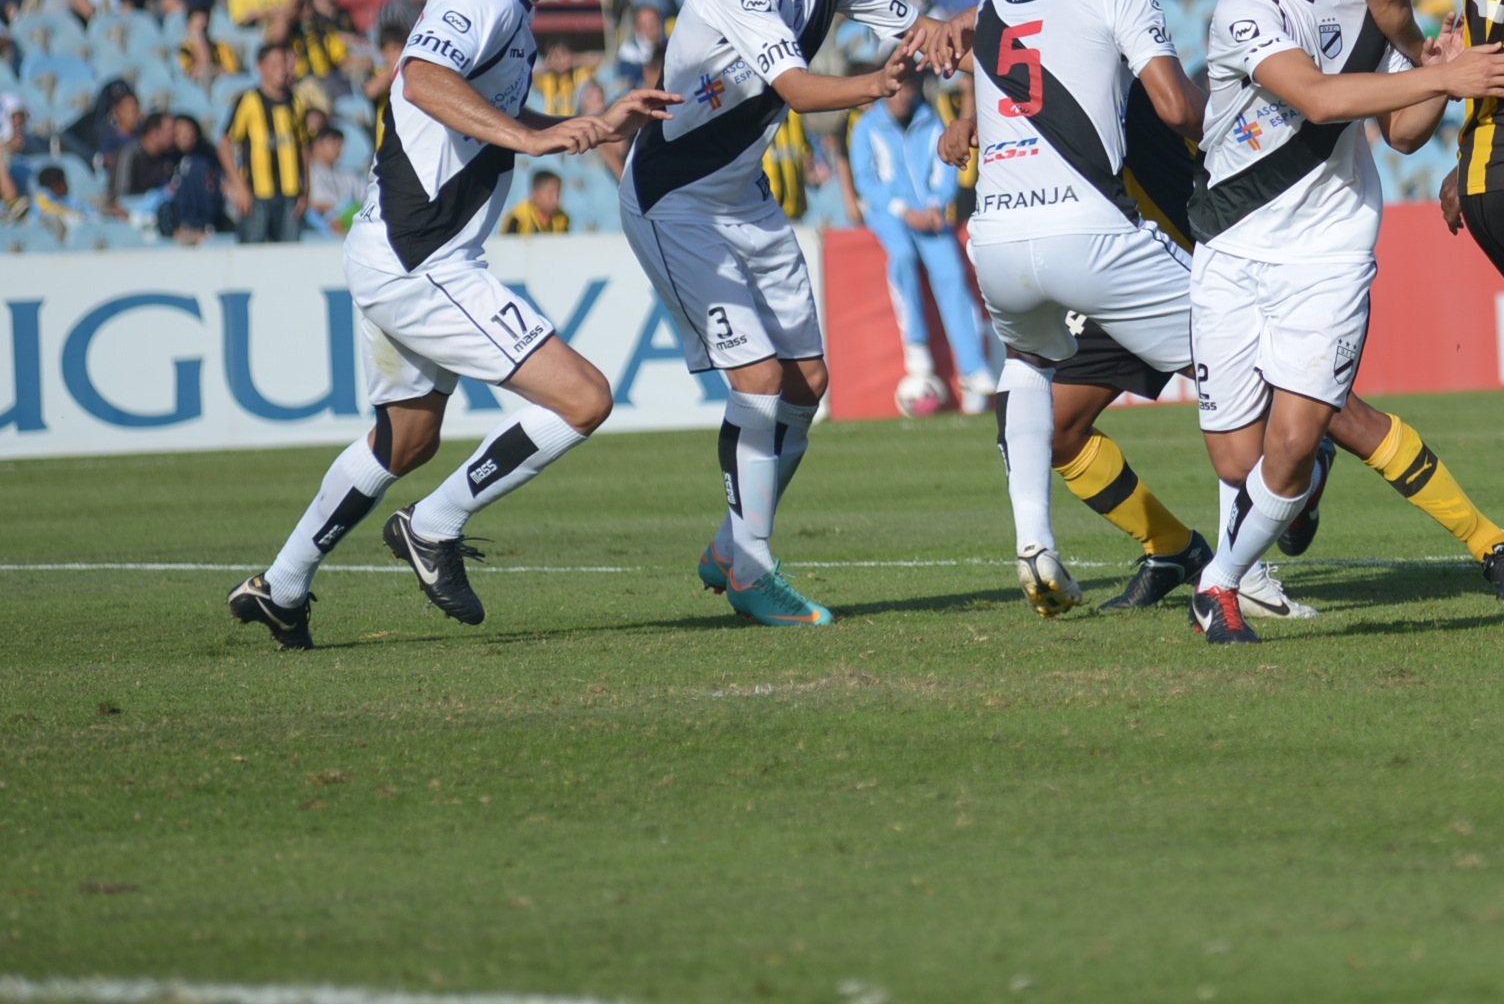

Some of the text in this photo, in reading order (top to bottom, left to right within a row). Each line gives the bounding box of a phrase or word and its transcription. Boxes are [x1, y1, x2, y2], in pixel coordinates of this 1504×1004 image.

[407, 31, 471, 70] antel
[757, 38, 803, 74] ante
[997, 20, 1044, 118] 5
[984, 185, 1079, 213] FRANJA
[490, 301, 527, 341] 17
[708, 306, 733, 340] 3
[513, 325, 544, 353] mass
[716, 335, 748, 350] mass
[1199, 401, 1217, 411] ass
[470, 458, 498, 485] mass
